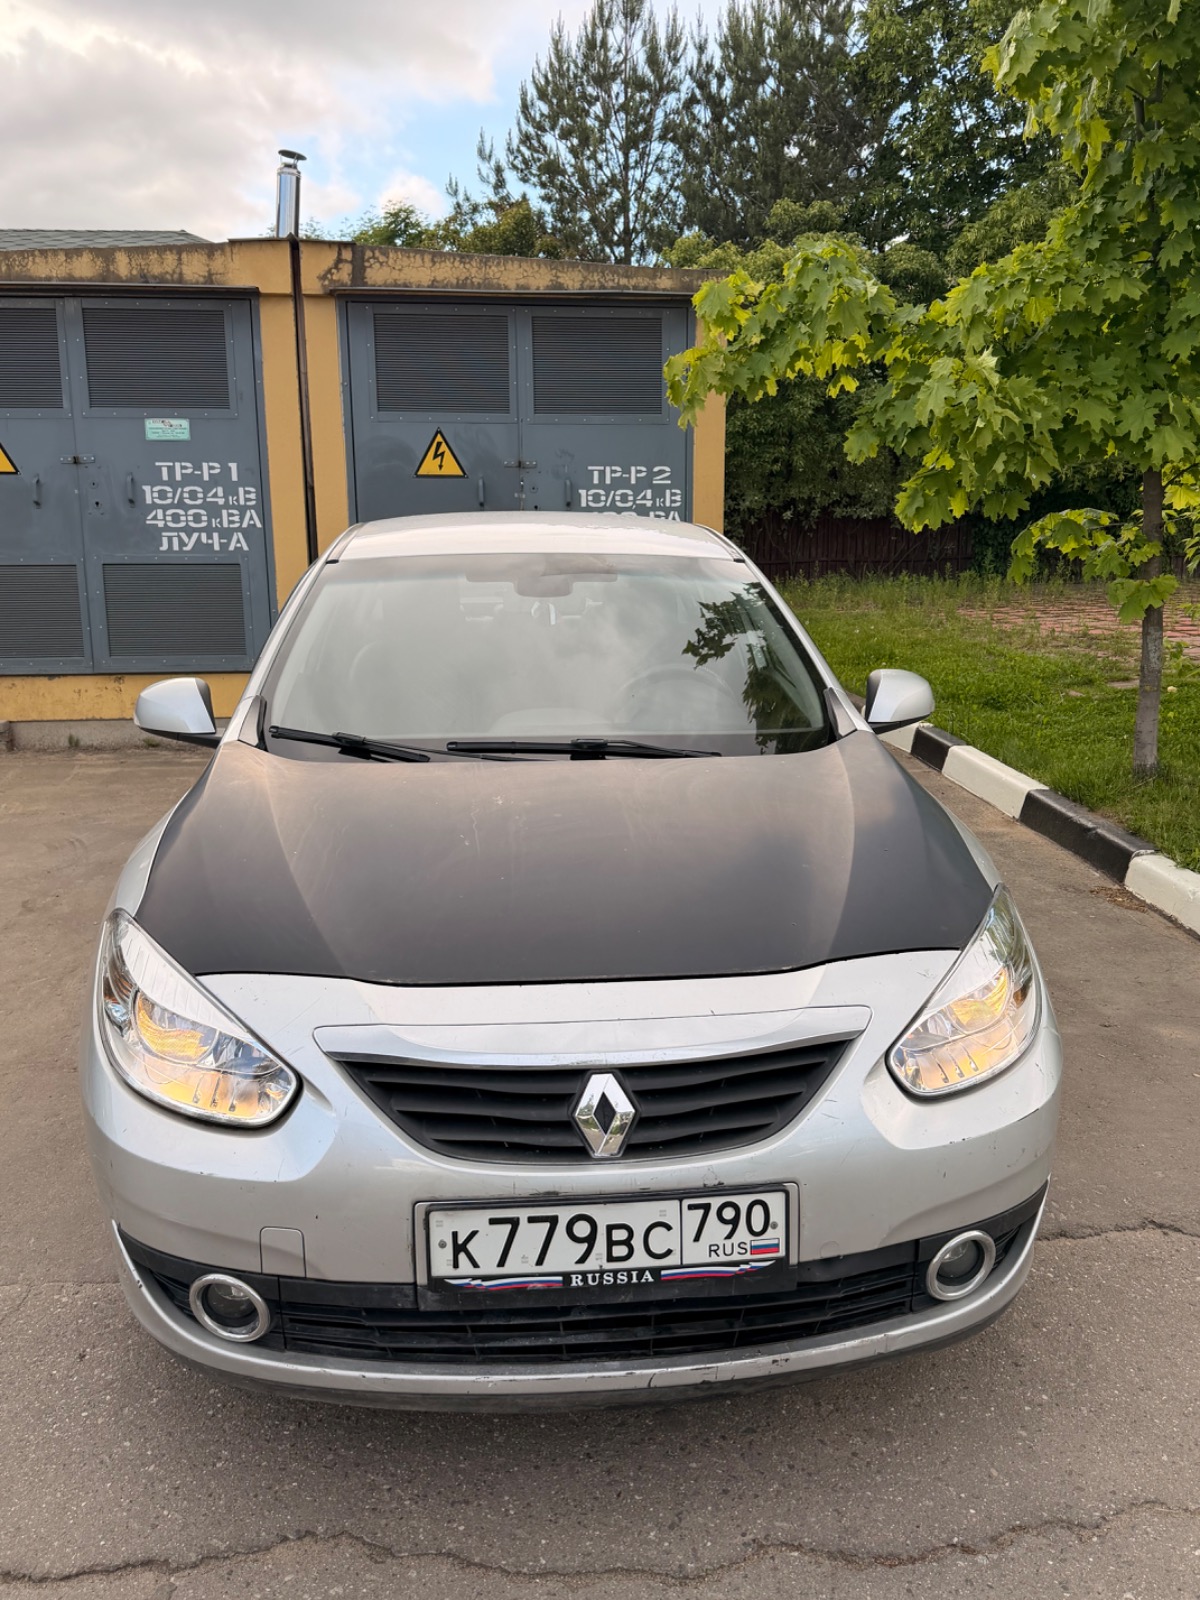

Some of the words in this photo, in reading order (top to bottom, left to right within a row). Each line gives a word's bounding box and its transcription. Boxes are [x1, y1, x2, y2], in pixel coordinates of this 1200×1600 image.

[154, 461, 222, 481] ТР-Р
[227, 462, 239, 481] 1
[587, 466, 648, 485] ТР-Р
[652, 465, 672, 484] 2
[578, 489, 653, 510] 10/0,4
[145, 508, 209, 528] 400
[211, 509, 263, 528] кВА
[159, 532, 250, 551] ЛУЧ-А
[687, 1198, 771, 1243] 790
[708, 1241, 749, 1258] RUS
[570, 1270, 655, 1287] RUSSIA
